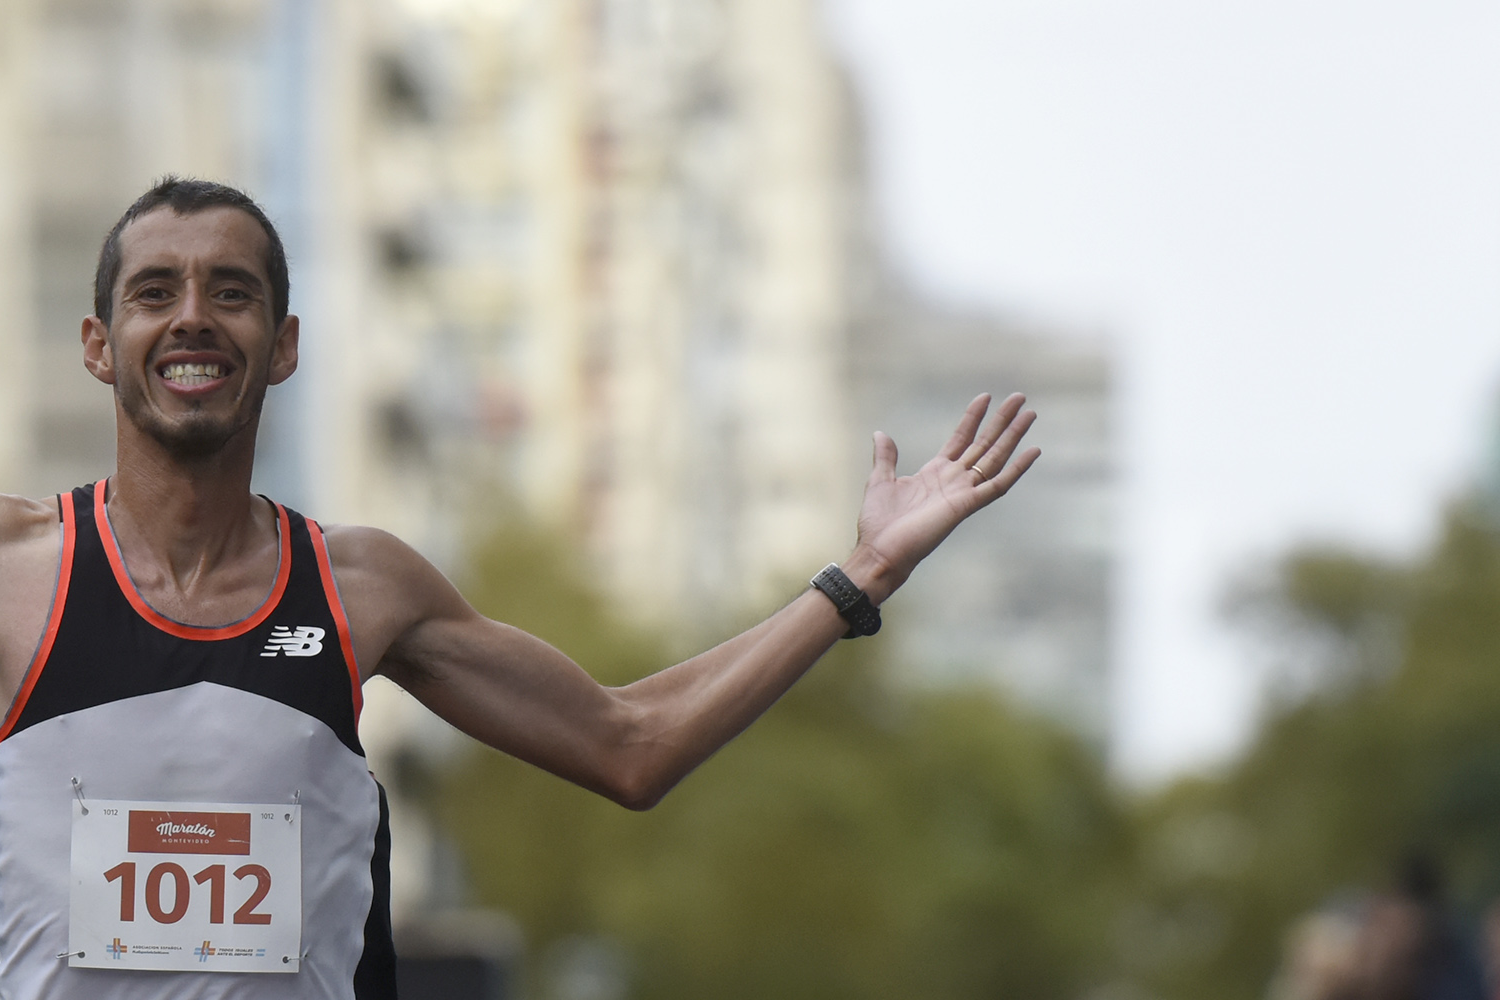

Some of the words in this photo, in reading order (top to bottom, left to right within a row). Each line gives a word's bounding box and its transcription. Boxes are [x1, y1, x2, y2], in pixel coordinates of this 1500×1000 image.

[260, 625, 326, 657] NB
[102, 808, 119, 816] 1012
[260, 812, 275, 820] 1012
[156, 821, 216, 838] Maratón
[103, 861, 273, 925] 1012
